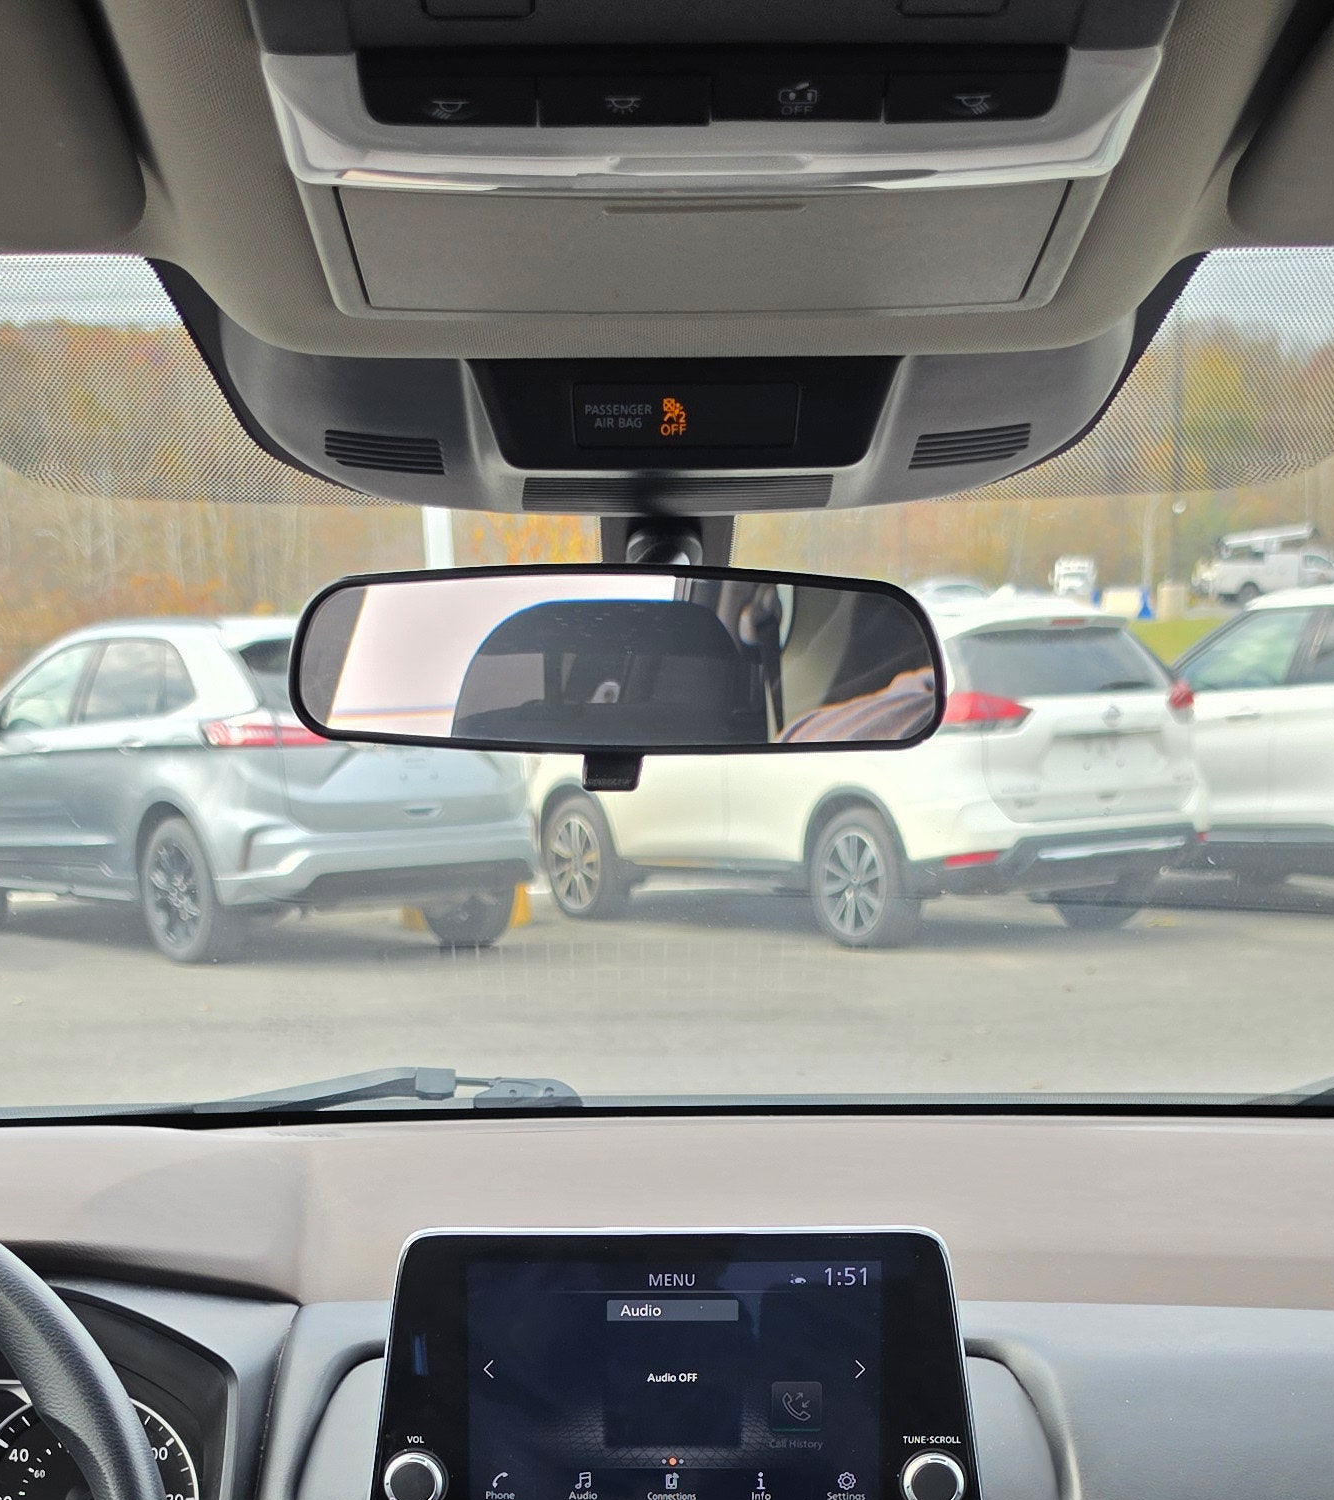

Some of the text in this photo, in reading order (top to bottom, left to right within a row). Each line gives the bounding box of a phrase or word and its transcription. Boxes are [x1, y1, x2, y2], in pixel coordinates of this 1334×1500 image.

[781, 106, 813, 115] OFF
[584, 404, 653, 416] PASSENGER
[594, 418, 687, 436] AIR BAG OFF
[648, 1267, 869, 1287] MENU 1:51
[620, 1304, 662, 1317] Audio
[647, 1372, 698, 1383] Audio OFF
[407, 1435, 425, 1444] VOL
[769, 1439, 824, 1451] Call History
[9, 1449, 29, 1462] 40
[152, 1446, 169, 1461] 00
[34, 1469, 46, 1479] 60
[485, 1490, 515, 1500] Phone
[569, 1491, 598, 1500] Audio
[647, 1491, 697, 1500] Connections
[751, 1491, 772, 1500] Info
